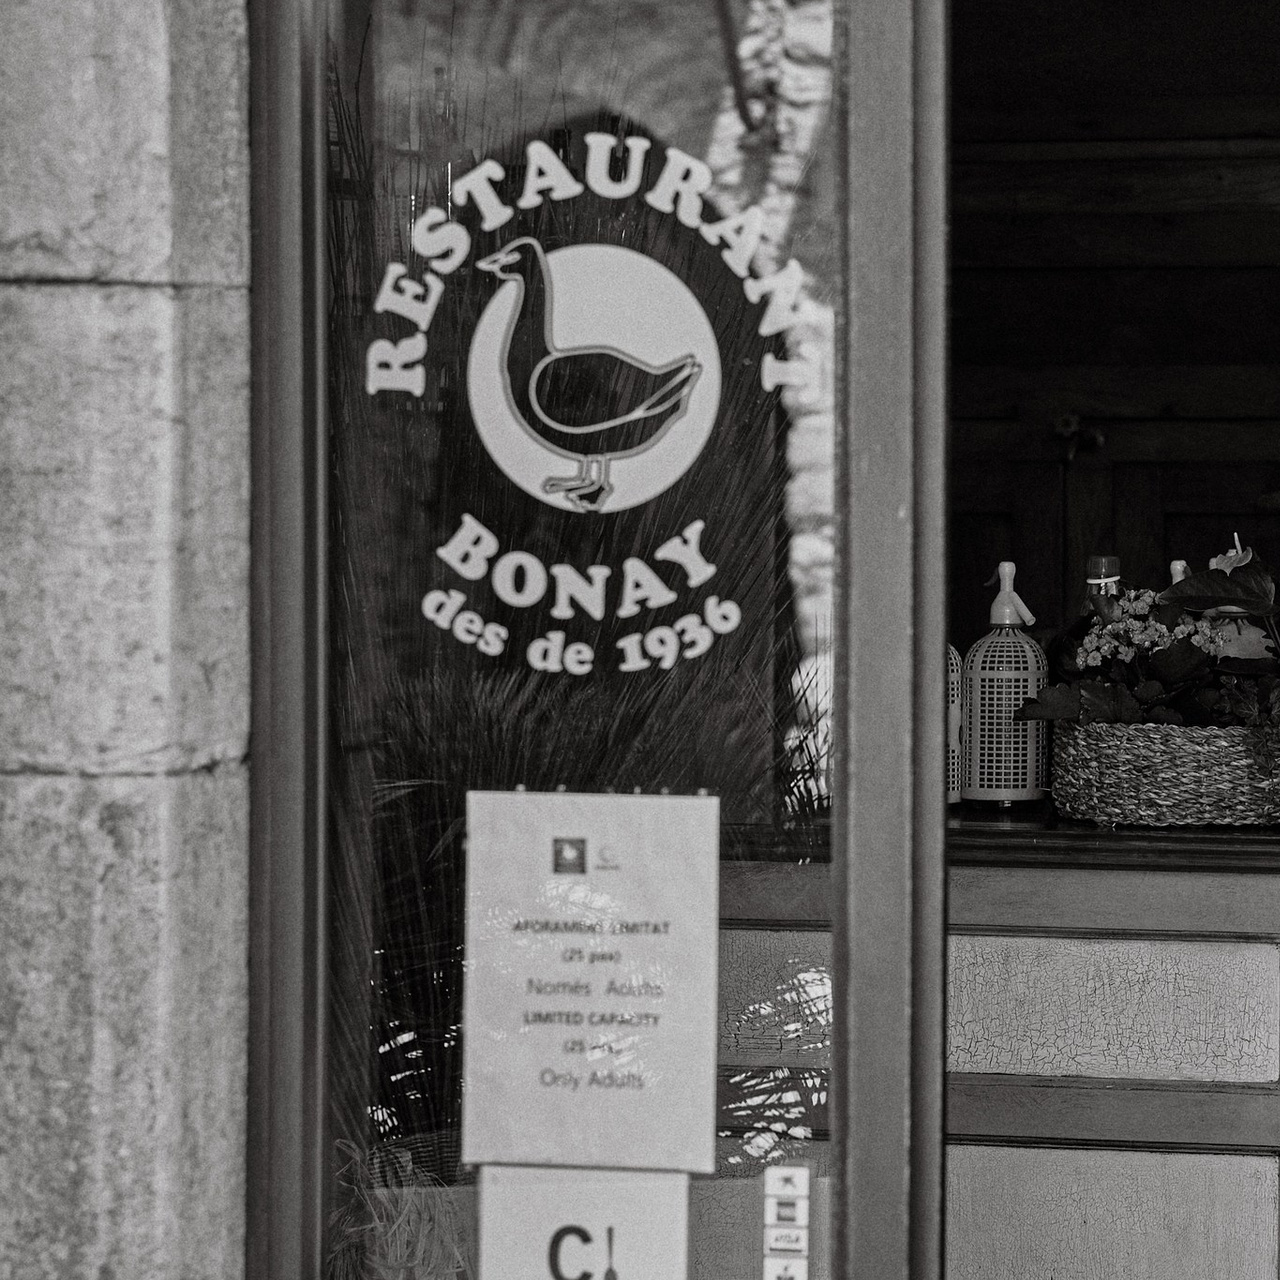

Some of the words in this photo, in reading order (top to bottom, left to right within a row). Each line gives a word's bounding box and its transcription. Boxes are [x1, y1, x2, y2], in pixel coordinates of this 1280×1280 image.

[437, 513, 717, 621] BONAY
[421, 588, 509, 656] des
[526, 630, 595, 675] de
[616, 595, 742, 673] 1936
[538, 1068, 580, 1092] Only
[588, 1070, 645, 1090] Adults
